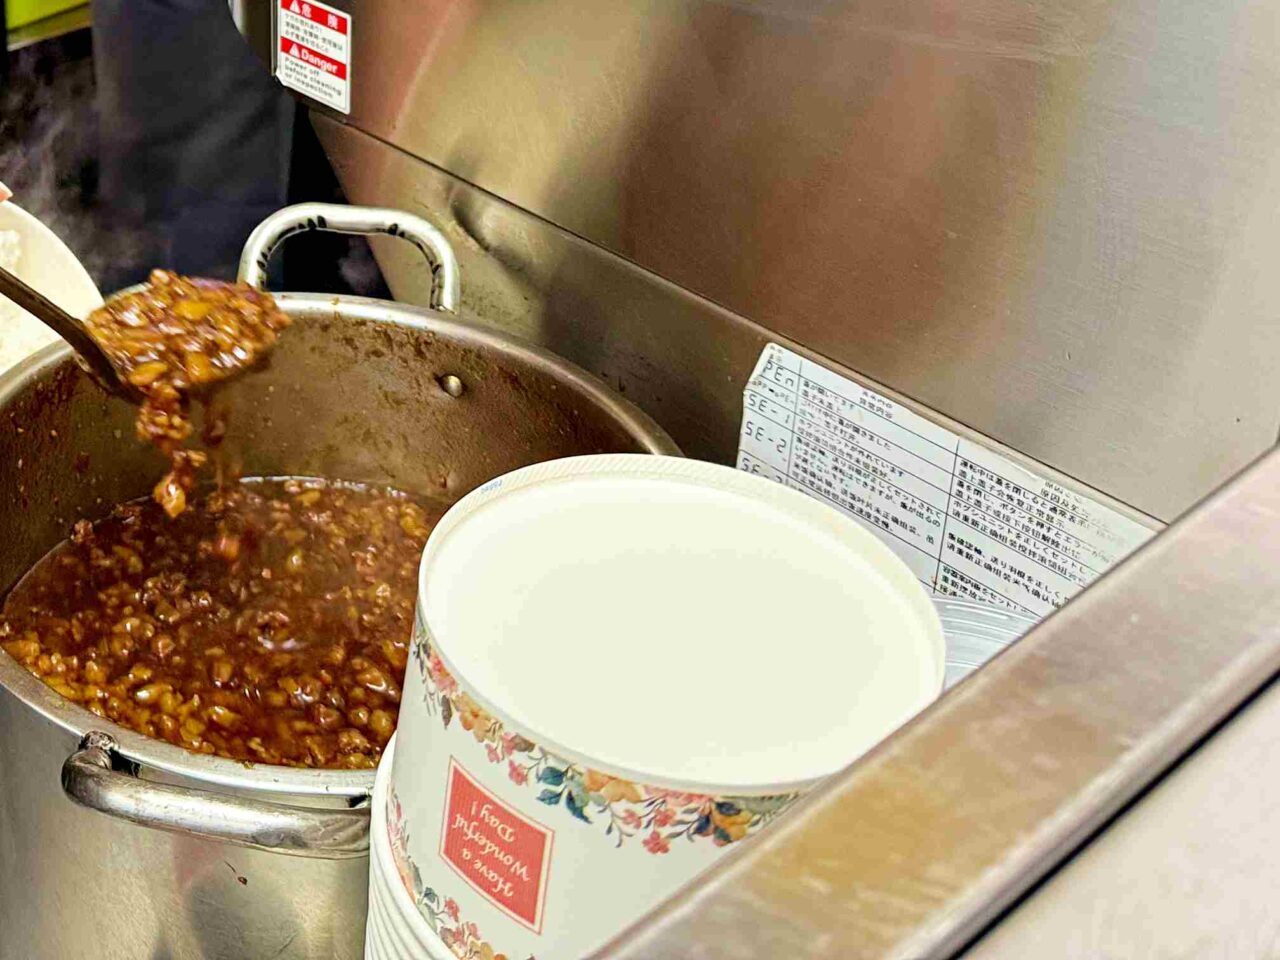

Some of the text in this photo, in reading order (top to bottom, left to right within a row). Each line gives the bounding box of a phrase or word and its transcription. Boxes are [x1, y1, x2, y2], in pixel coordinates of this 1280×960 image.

[301, 49, 339, 73] Danger
[452, 813, 530, 882] Wonderful
[462, 848, 515, 897] Have a
